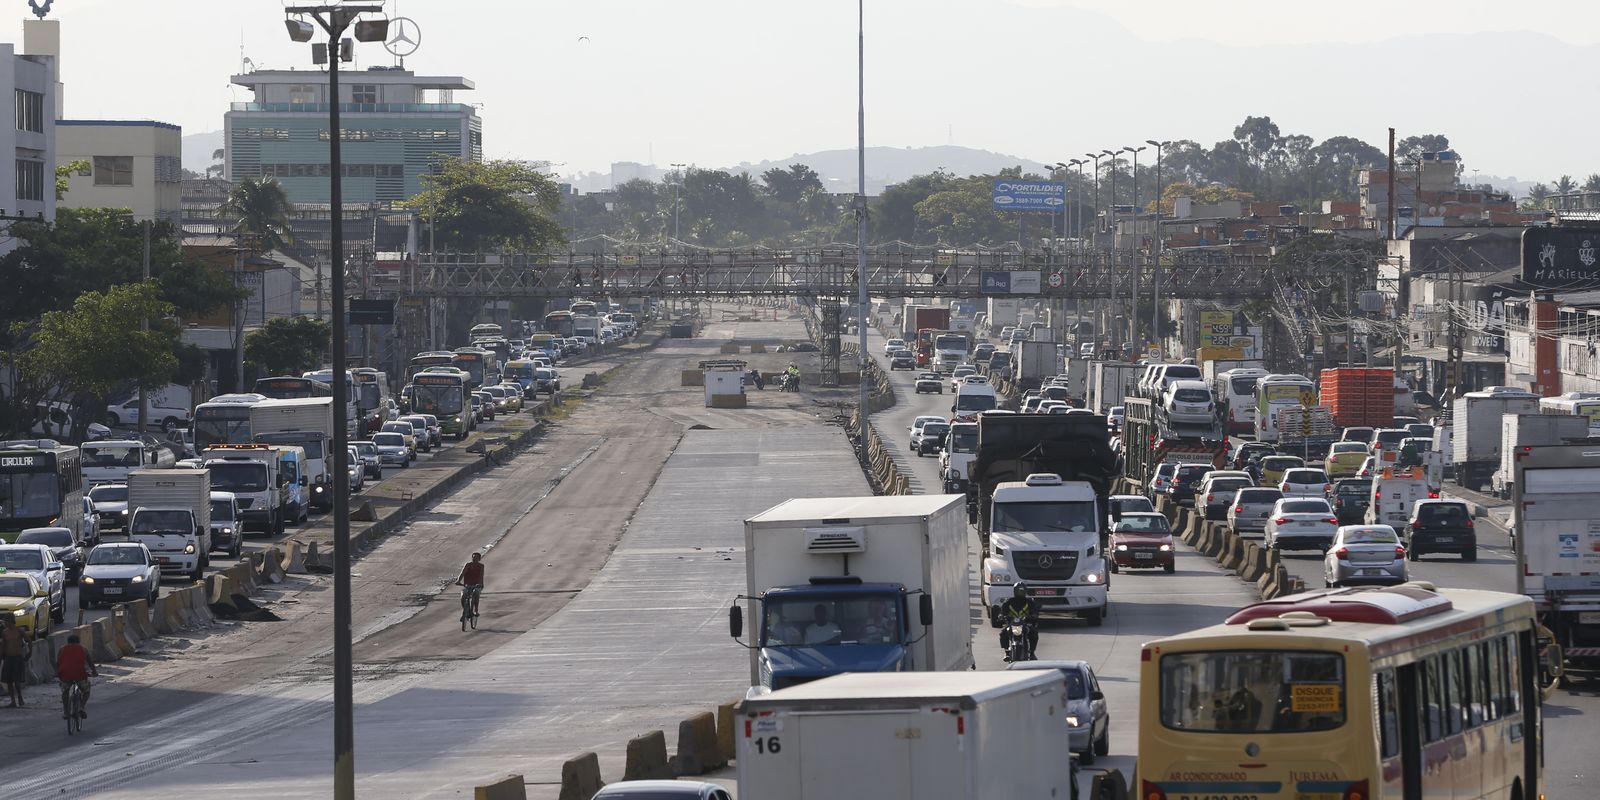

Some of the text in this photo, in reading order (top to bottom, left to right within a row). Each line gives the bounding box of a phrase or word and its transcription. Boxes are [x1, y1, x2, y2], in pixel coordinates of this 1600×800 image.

[1, 456, 34, 467] CIRCULAR
[1296, 687, 1334, 696] DISQUE
[755, 736, 781, 754] 16
[1170, 771, 1248, 781] AR CONDICIONADO
